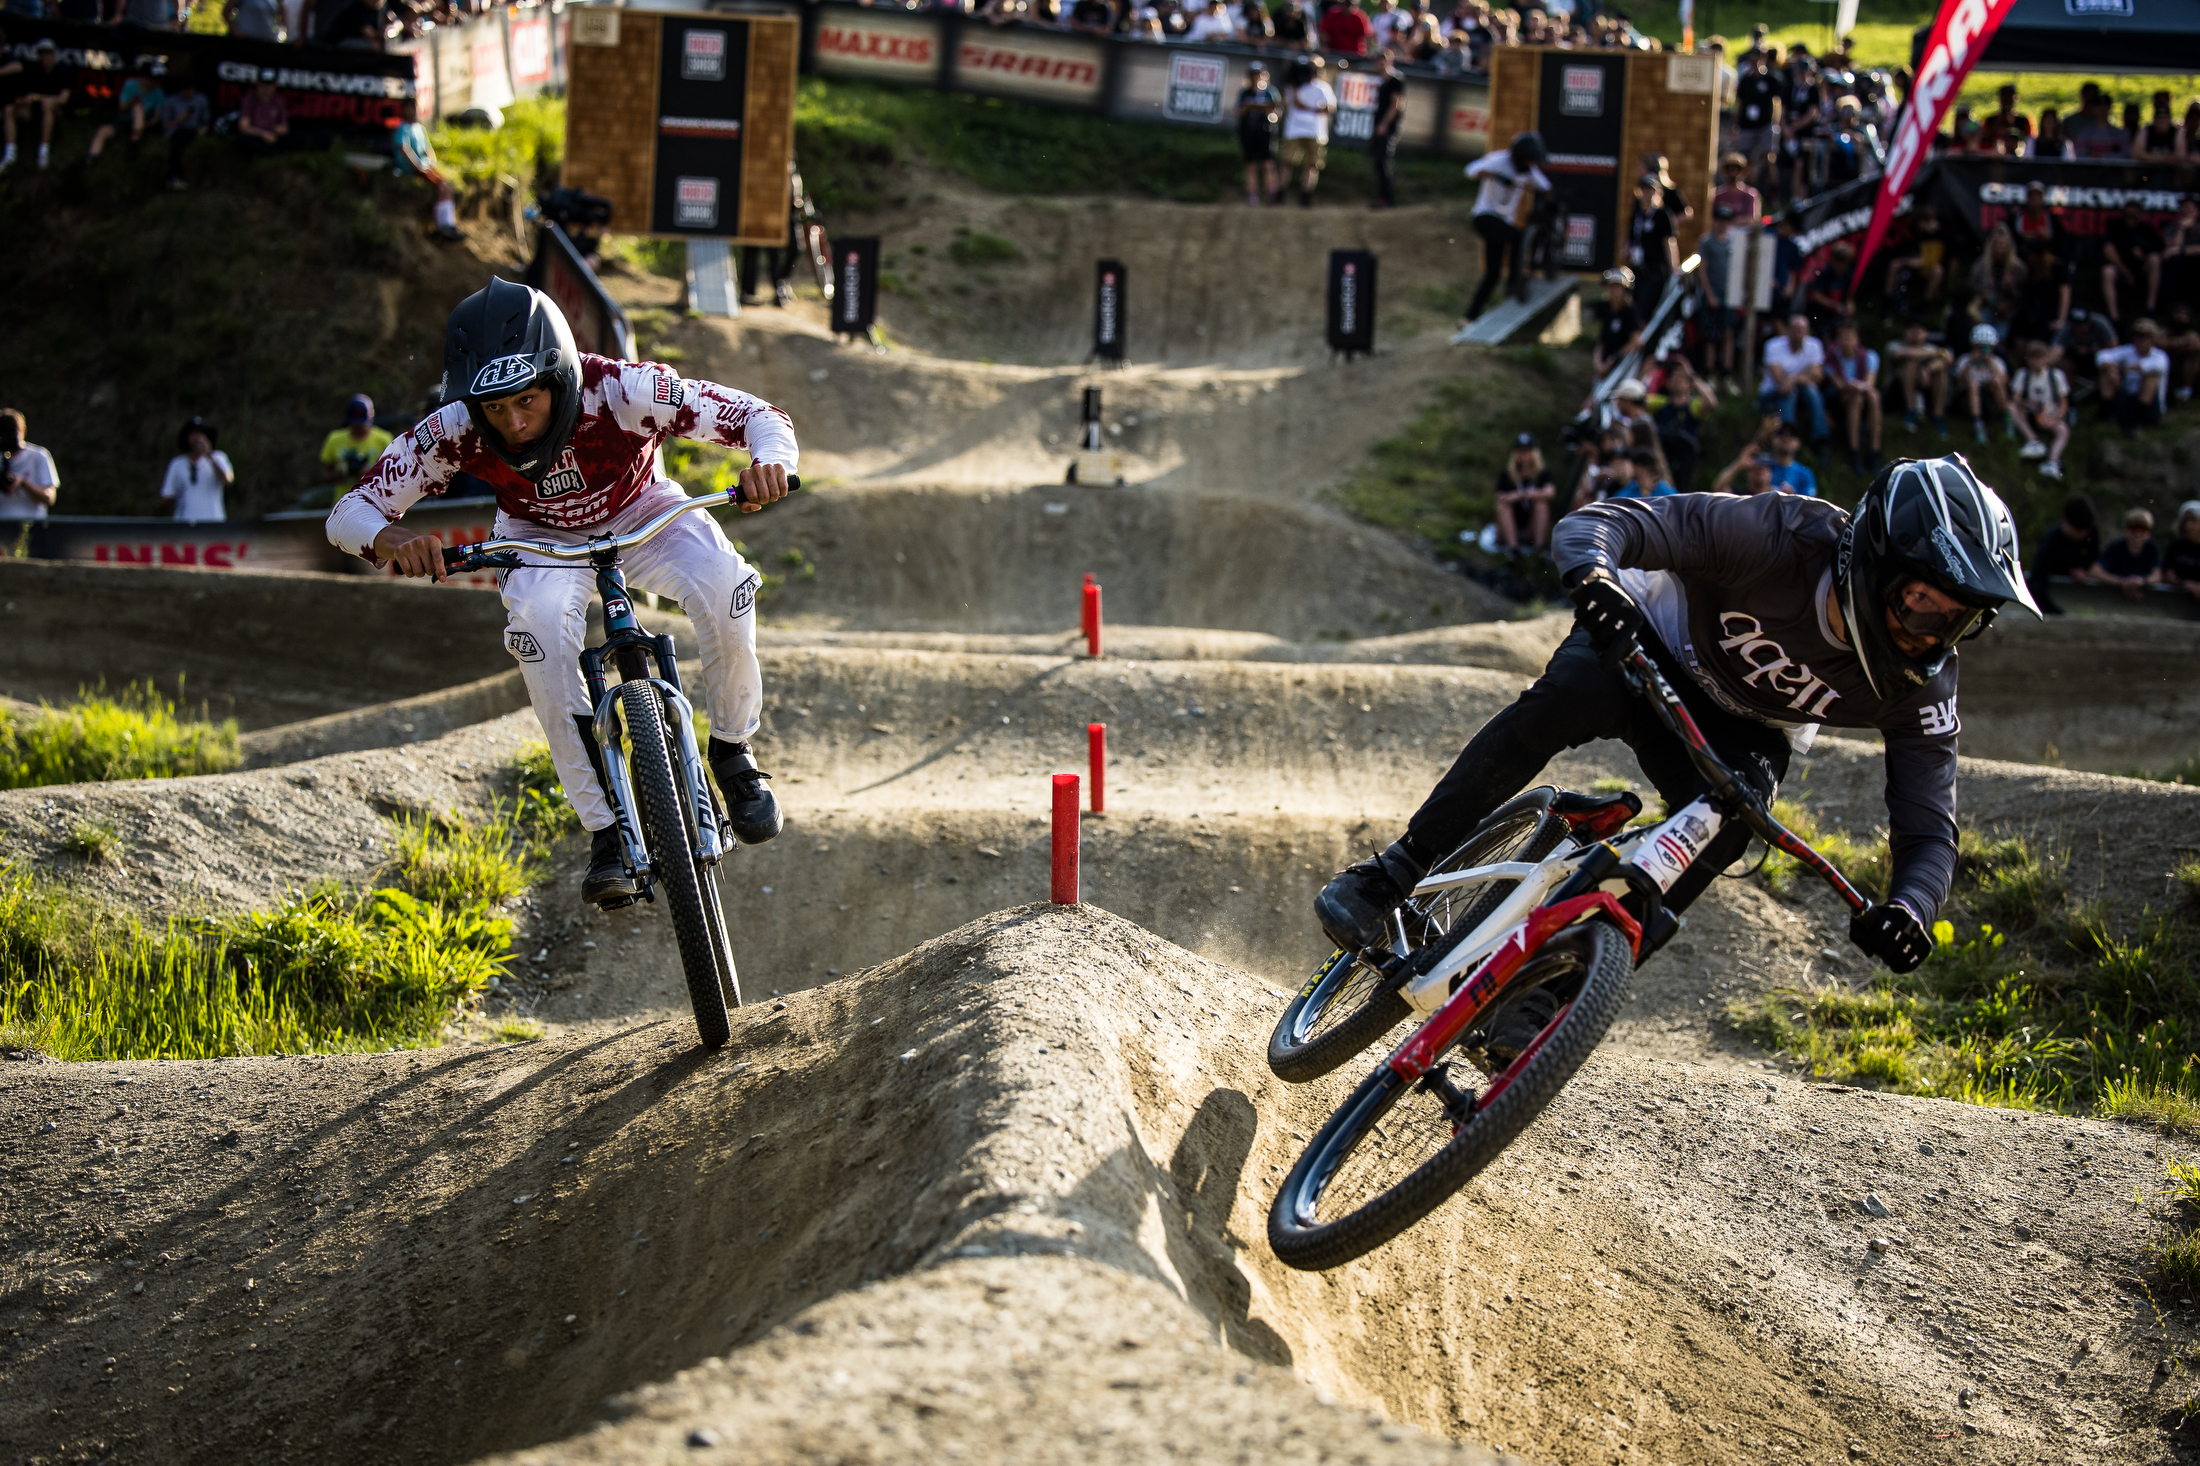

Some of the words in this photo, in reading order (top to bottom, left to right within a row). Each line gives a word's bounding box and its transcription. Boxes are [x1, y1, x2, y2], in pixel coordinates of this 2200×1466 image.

[817, 26, 931, 64] MAXXIS
[958, 46, 1096, 84] SRAM
[416, 425, 433, 451] SHOX
[542, 472, 581, 495] SHOX
[1669, 827, 1698, 857] KING
[1881, 919, 1918, 963] FIST
